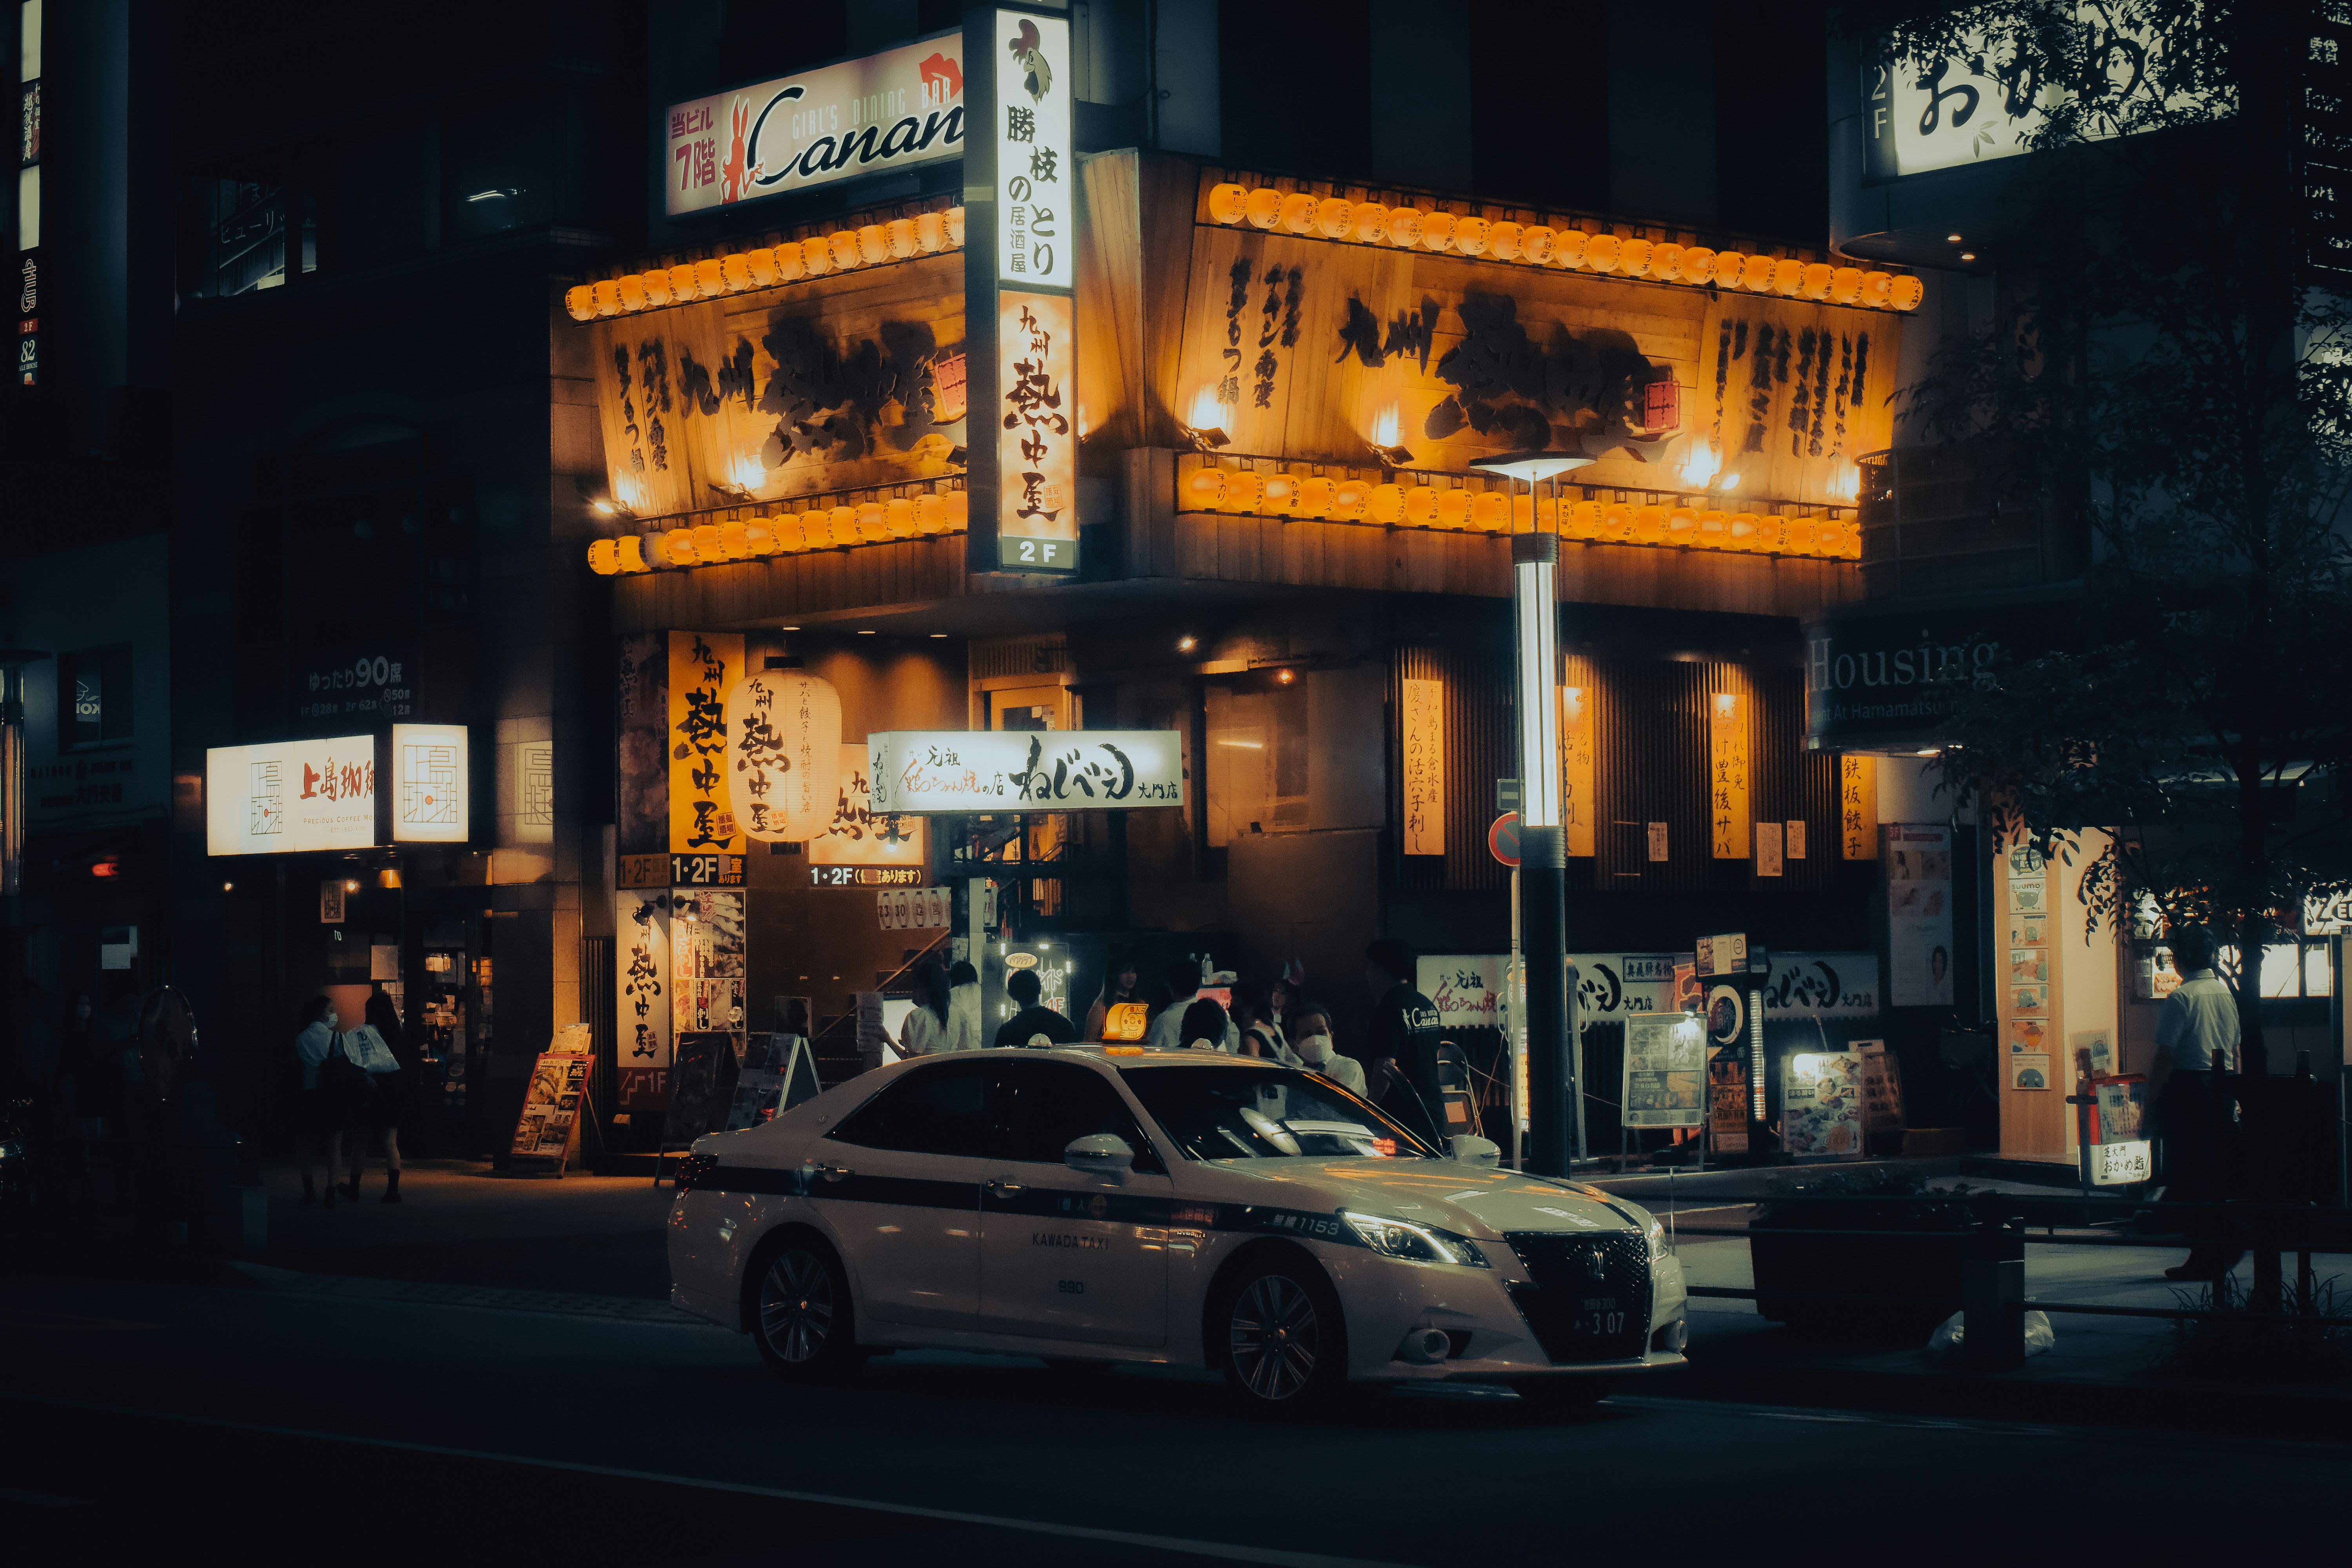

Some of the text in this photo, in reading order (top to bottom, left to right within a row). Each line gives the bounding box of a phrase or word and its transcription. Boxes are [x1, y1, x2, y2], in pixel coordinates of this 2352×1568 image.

[792, 77, 951, 139] GIRL'S DINING BAR
[671, 106, 714, 140] 当ビル
[675, 137, 716, 192] 7階
[24, 320, 33, 332] 2F
[21, 339, 36, 362] 82
[26, 361, 38, 371] HOUSE
[1020, 541, 1056, 562] 2F
[1810, 629, 2000, 692] Housing
[1834, 707, 1846, 720] At
[1575, 692, 1590, 765] 呼子名物
[926, 745, 960, 766] 元祖
[1138, 782, 1178, 799] 大門店
[1842, 759, 1862, 857] 鉄板餃子
[1454, 970, 1483, 989] 元祖
[2104, 1145, 2126, 1158] 芝大門
[1033, 1233, 1109, 1250] KAWADA TAXI
